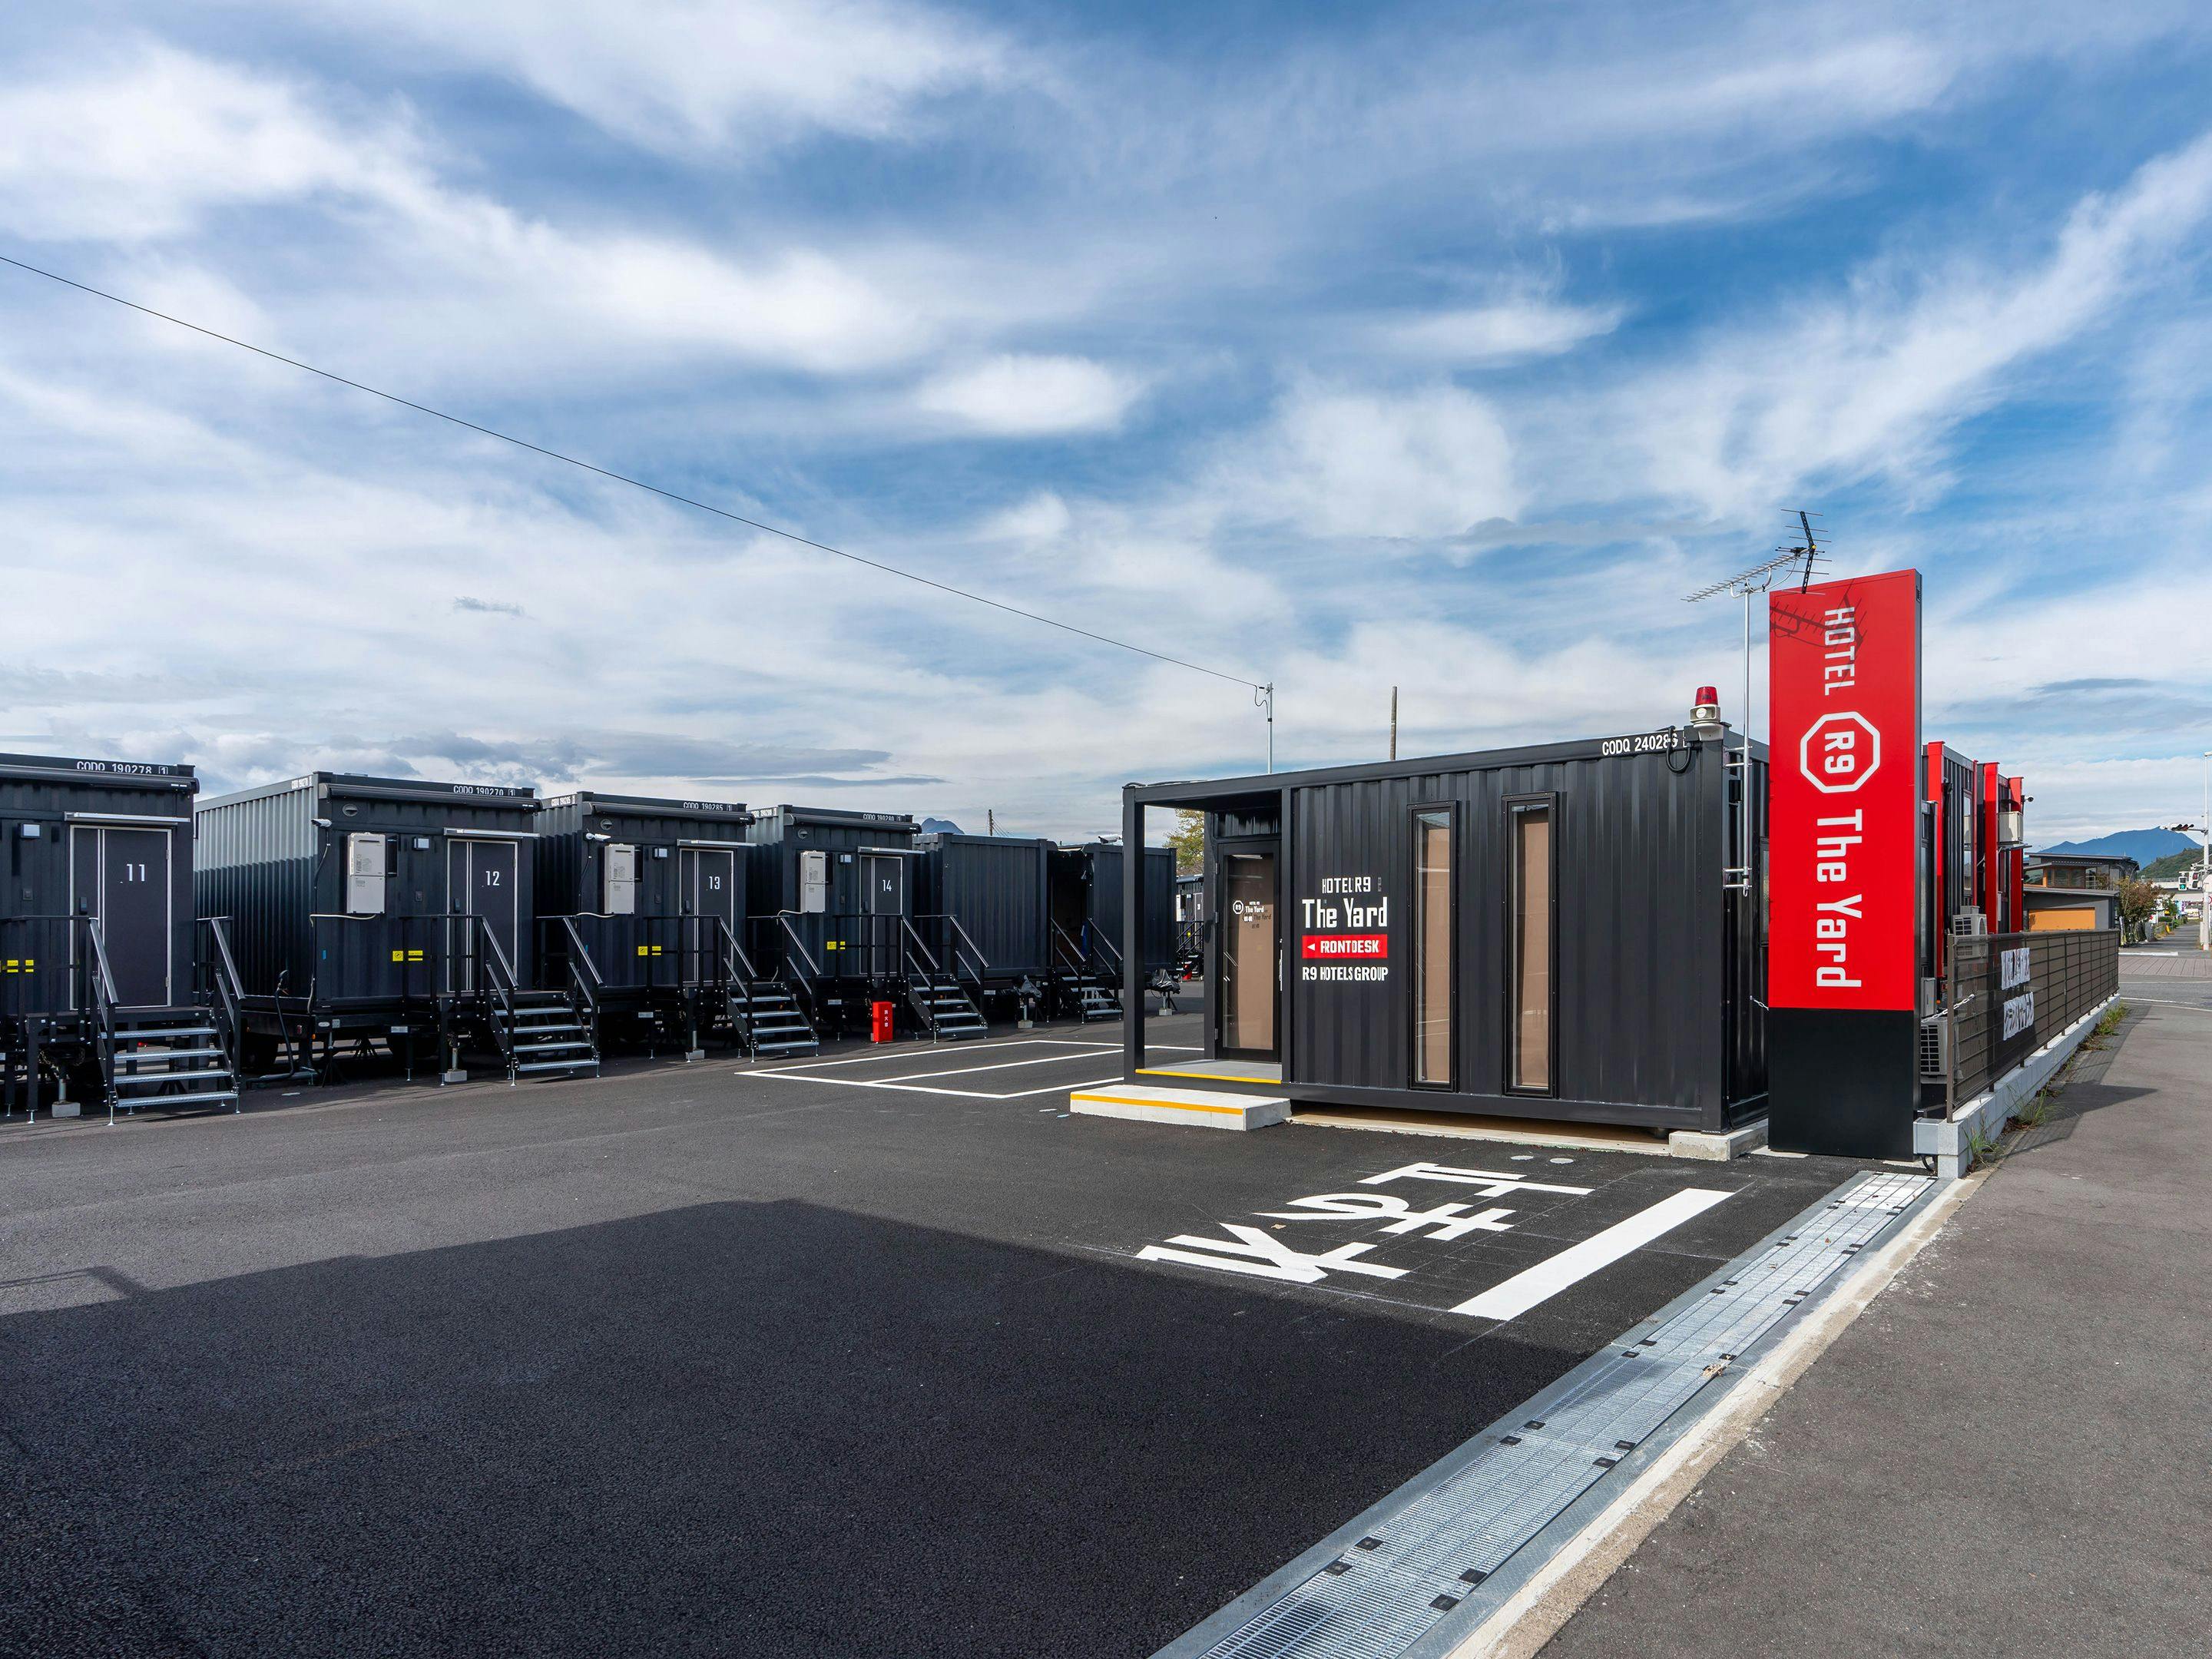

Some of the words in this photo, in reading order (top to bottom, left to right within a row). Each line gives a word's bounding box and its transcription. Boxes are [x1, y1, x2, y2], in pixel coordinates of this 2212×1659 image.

[1824, 607, 1855, 696] HOTEL
[1602, 738, 1631, 756] CODQ
[1824, 730, 1855, 774] R9
[1816, 809, 1863, 882] The
[127, 863, 145, 882] 11
[485, 870, 500, 886] 12
[709, 876, 720, 889] 13
[882, 879, 892, 892] 14
[1322, 877, 1352, 894] HOTEL
[1355, 876, 1371, 892] R9
[1302, 898, 1337, 929] The
[1343, 896, 1388, 928] Yard
[1816, 893, 1863, 988] Yard
[1303, 966, 1317, 981] R9
[1354, 966, 1389, 982] GROUP
[1134, 1161, 1595, 1284] 止まれ
